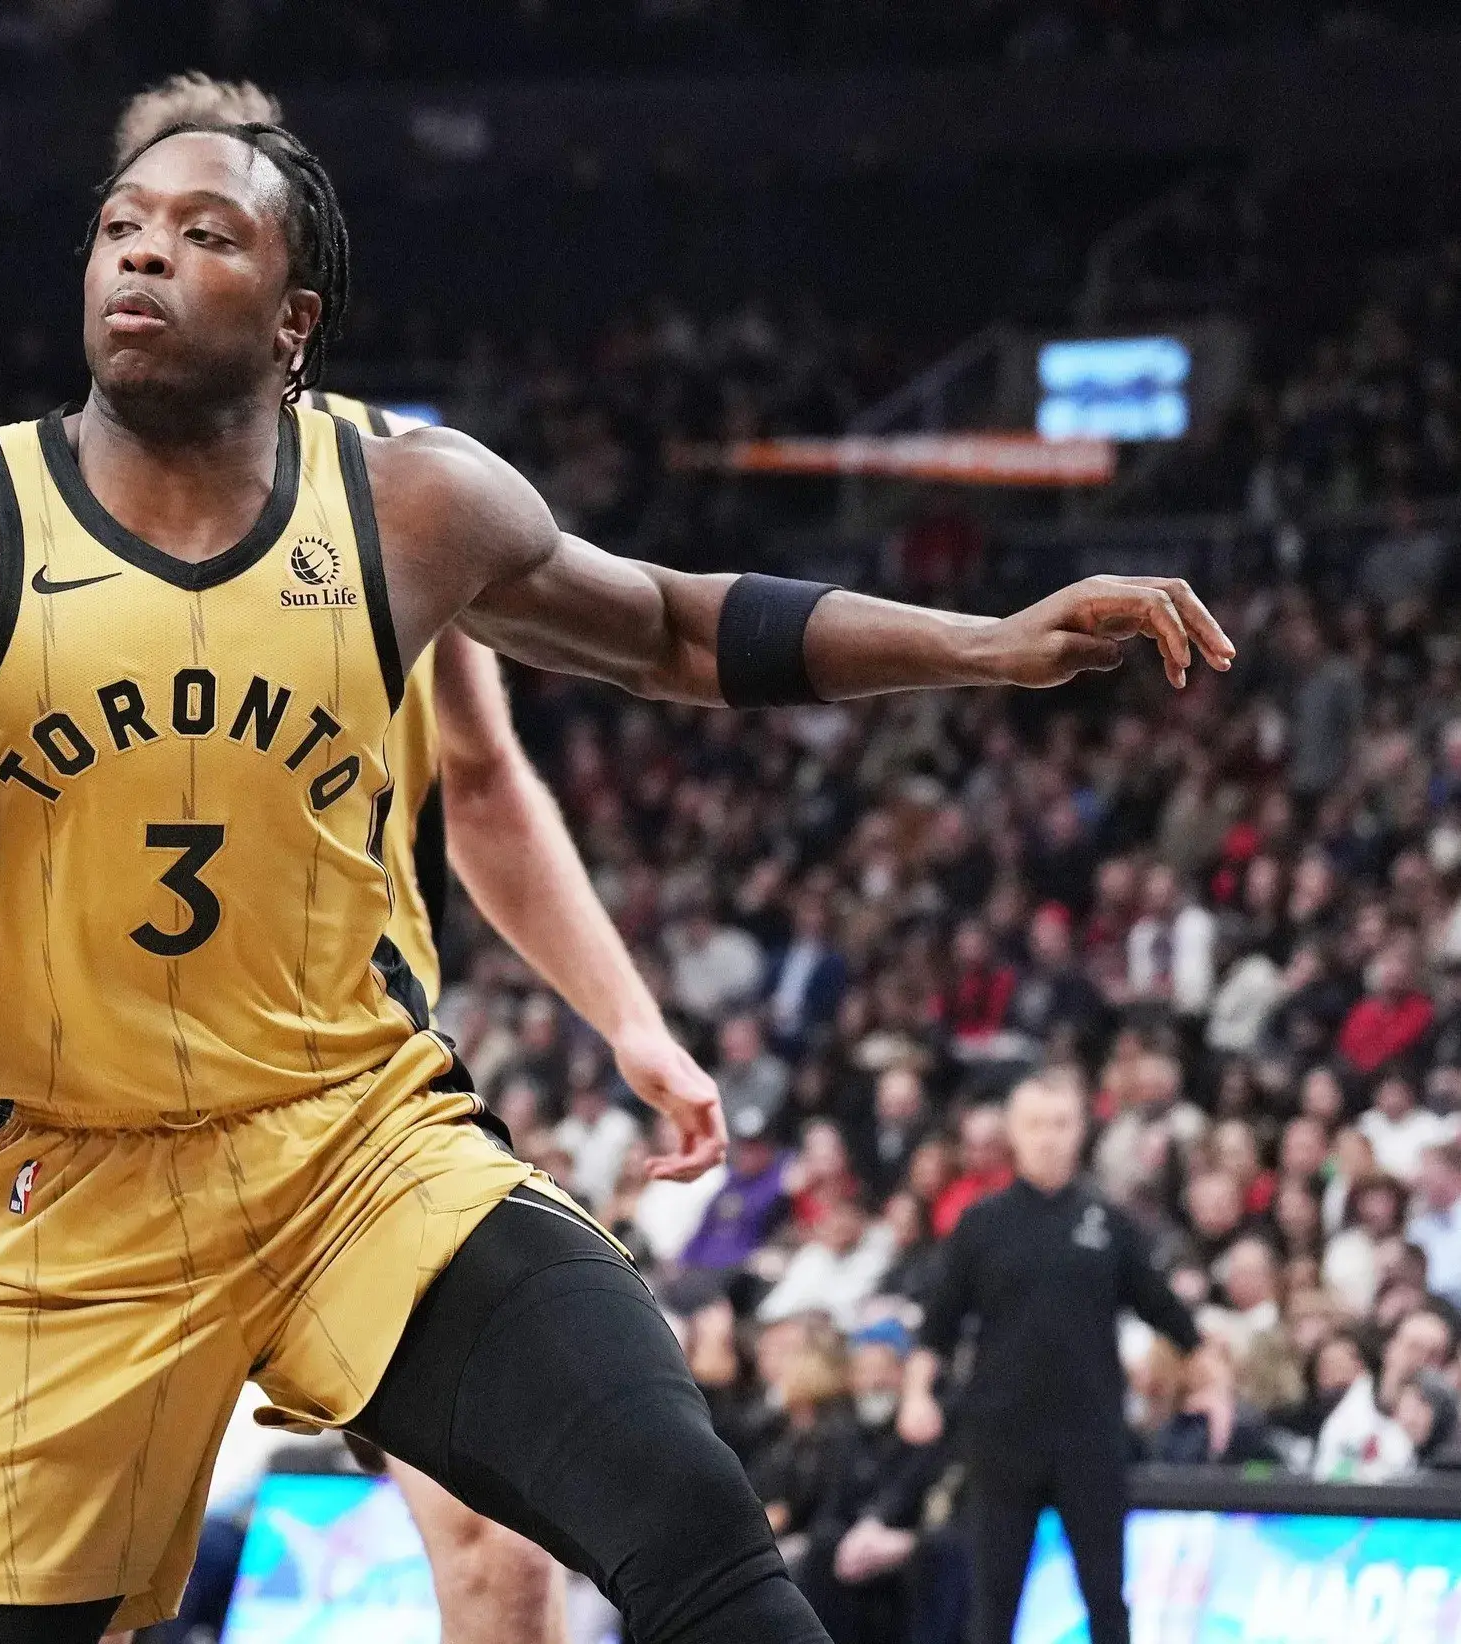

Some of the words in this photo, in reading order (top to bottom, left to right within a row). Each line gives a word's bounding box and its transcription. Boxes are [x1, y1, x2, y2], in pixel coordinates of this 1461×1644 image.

[280, 590, 319, 606] Sun
[322, 587, 357, 605] Life
[128, 820, 227, 957] 3
